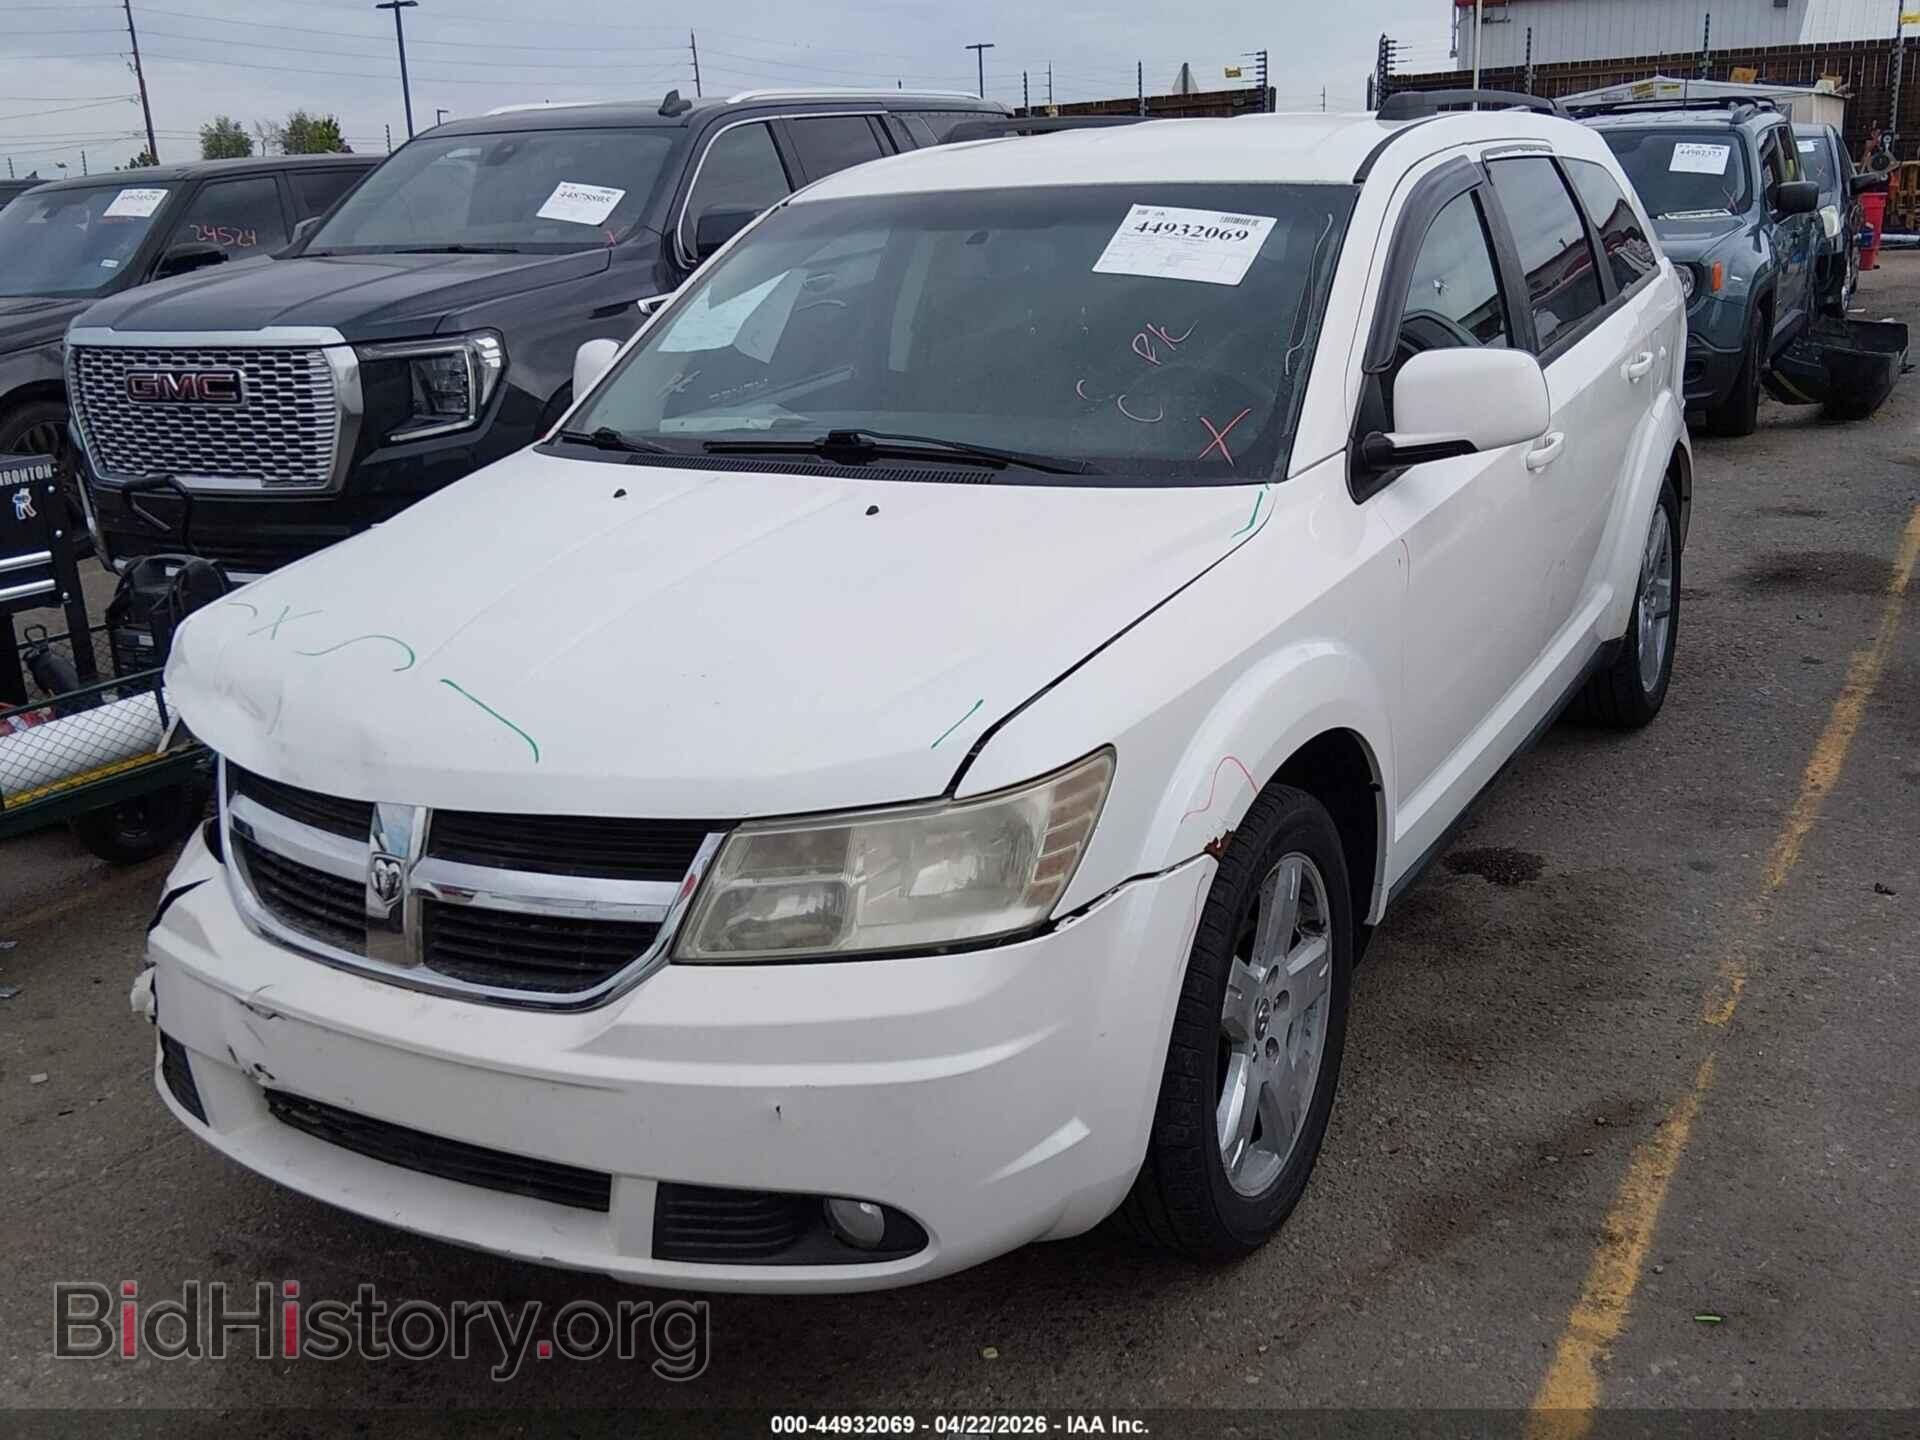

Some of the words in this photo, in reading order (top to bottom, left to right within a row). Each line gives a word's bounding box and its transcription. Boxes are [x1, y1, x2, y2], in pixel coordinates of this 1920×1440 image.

[189, 224, 257, 247] 24524
[1133, 220, 1250, 242] 44932069
[127, 373, 238, 401] GMC
[0, 463, 53, 486] IRONTON
